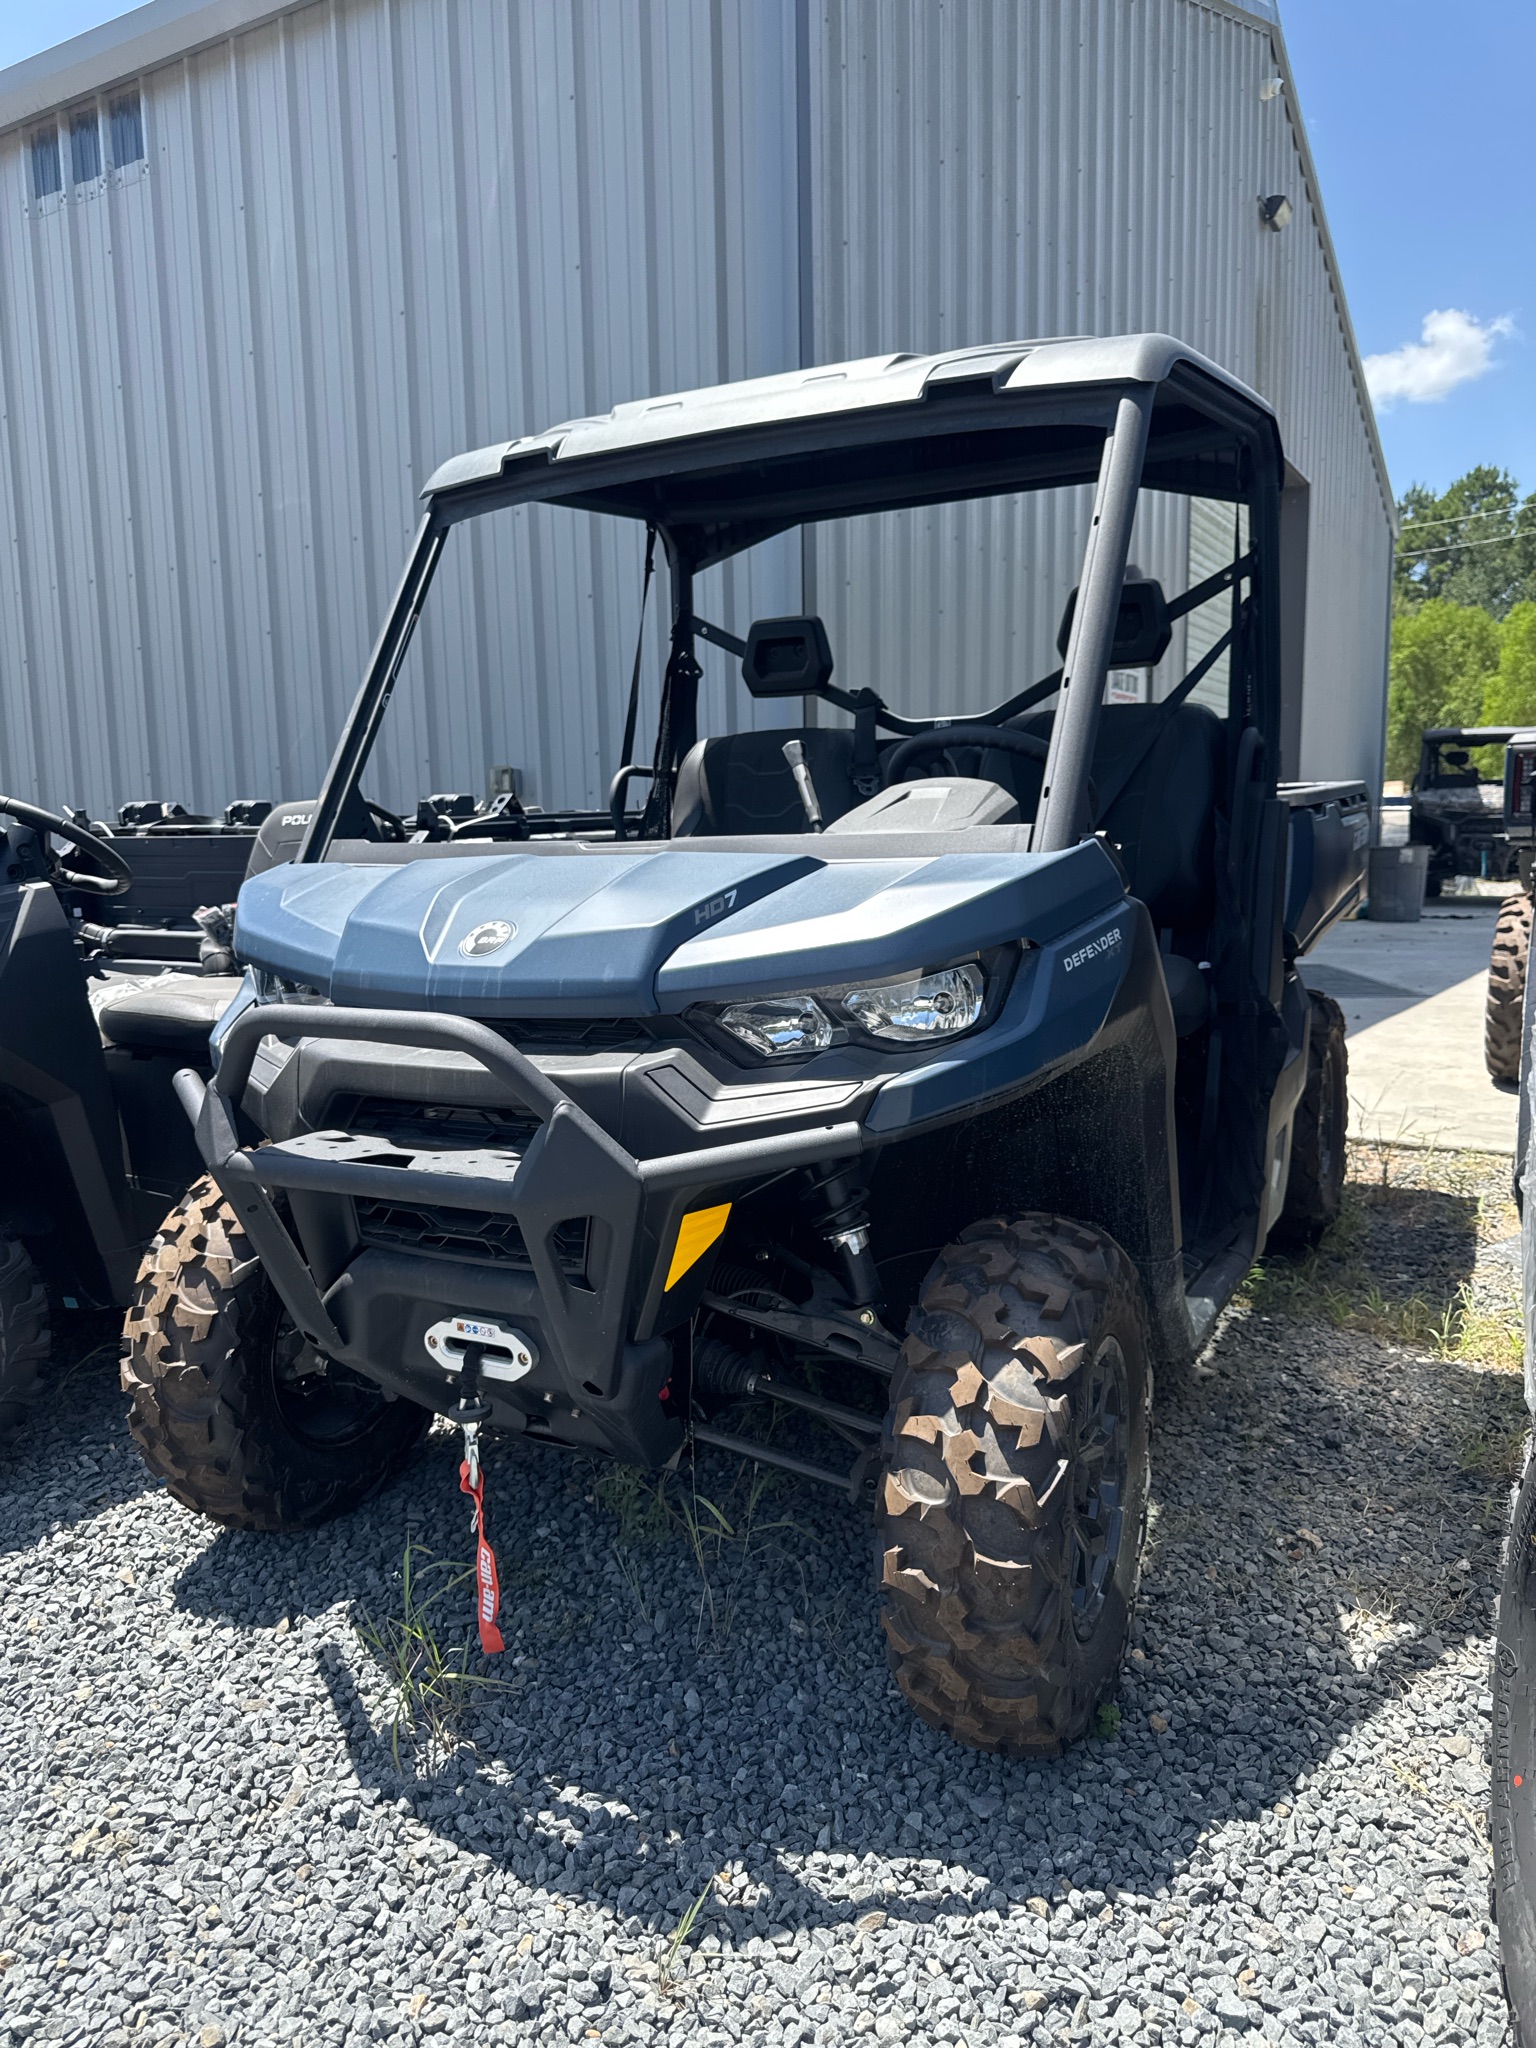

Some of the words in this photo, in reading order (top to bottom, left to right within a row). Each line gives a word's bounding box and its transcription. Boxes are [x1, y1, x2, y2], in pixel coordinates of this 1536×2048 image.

[694, 888, 738, 926] HD7
[1063, 927, 1122, 972] DEFENDER
[480, 1546, 495, 1623] can-am
